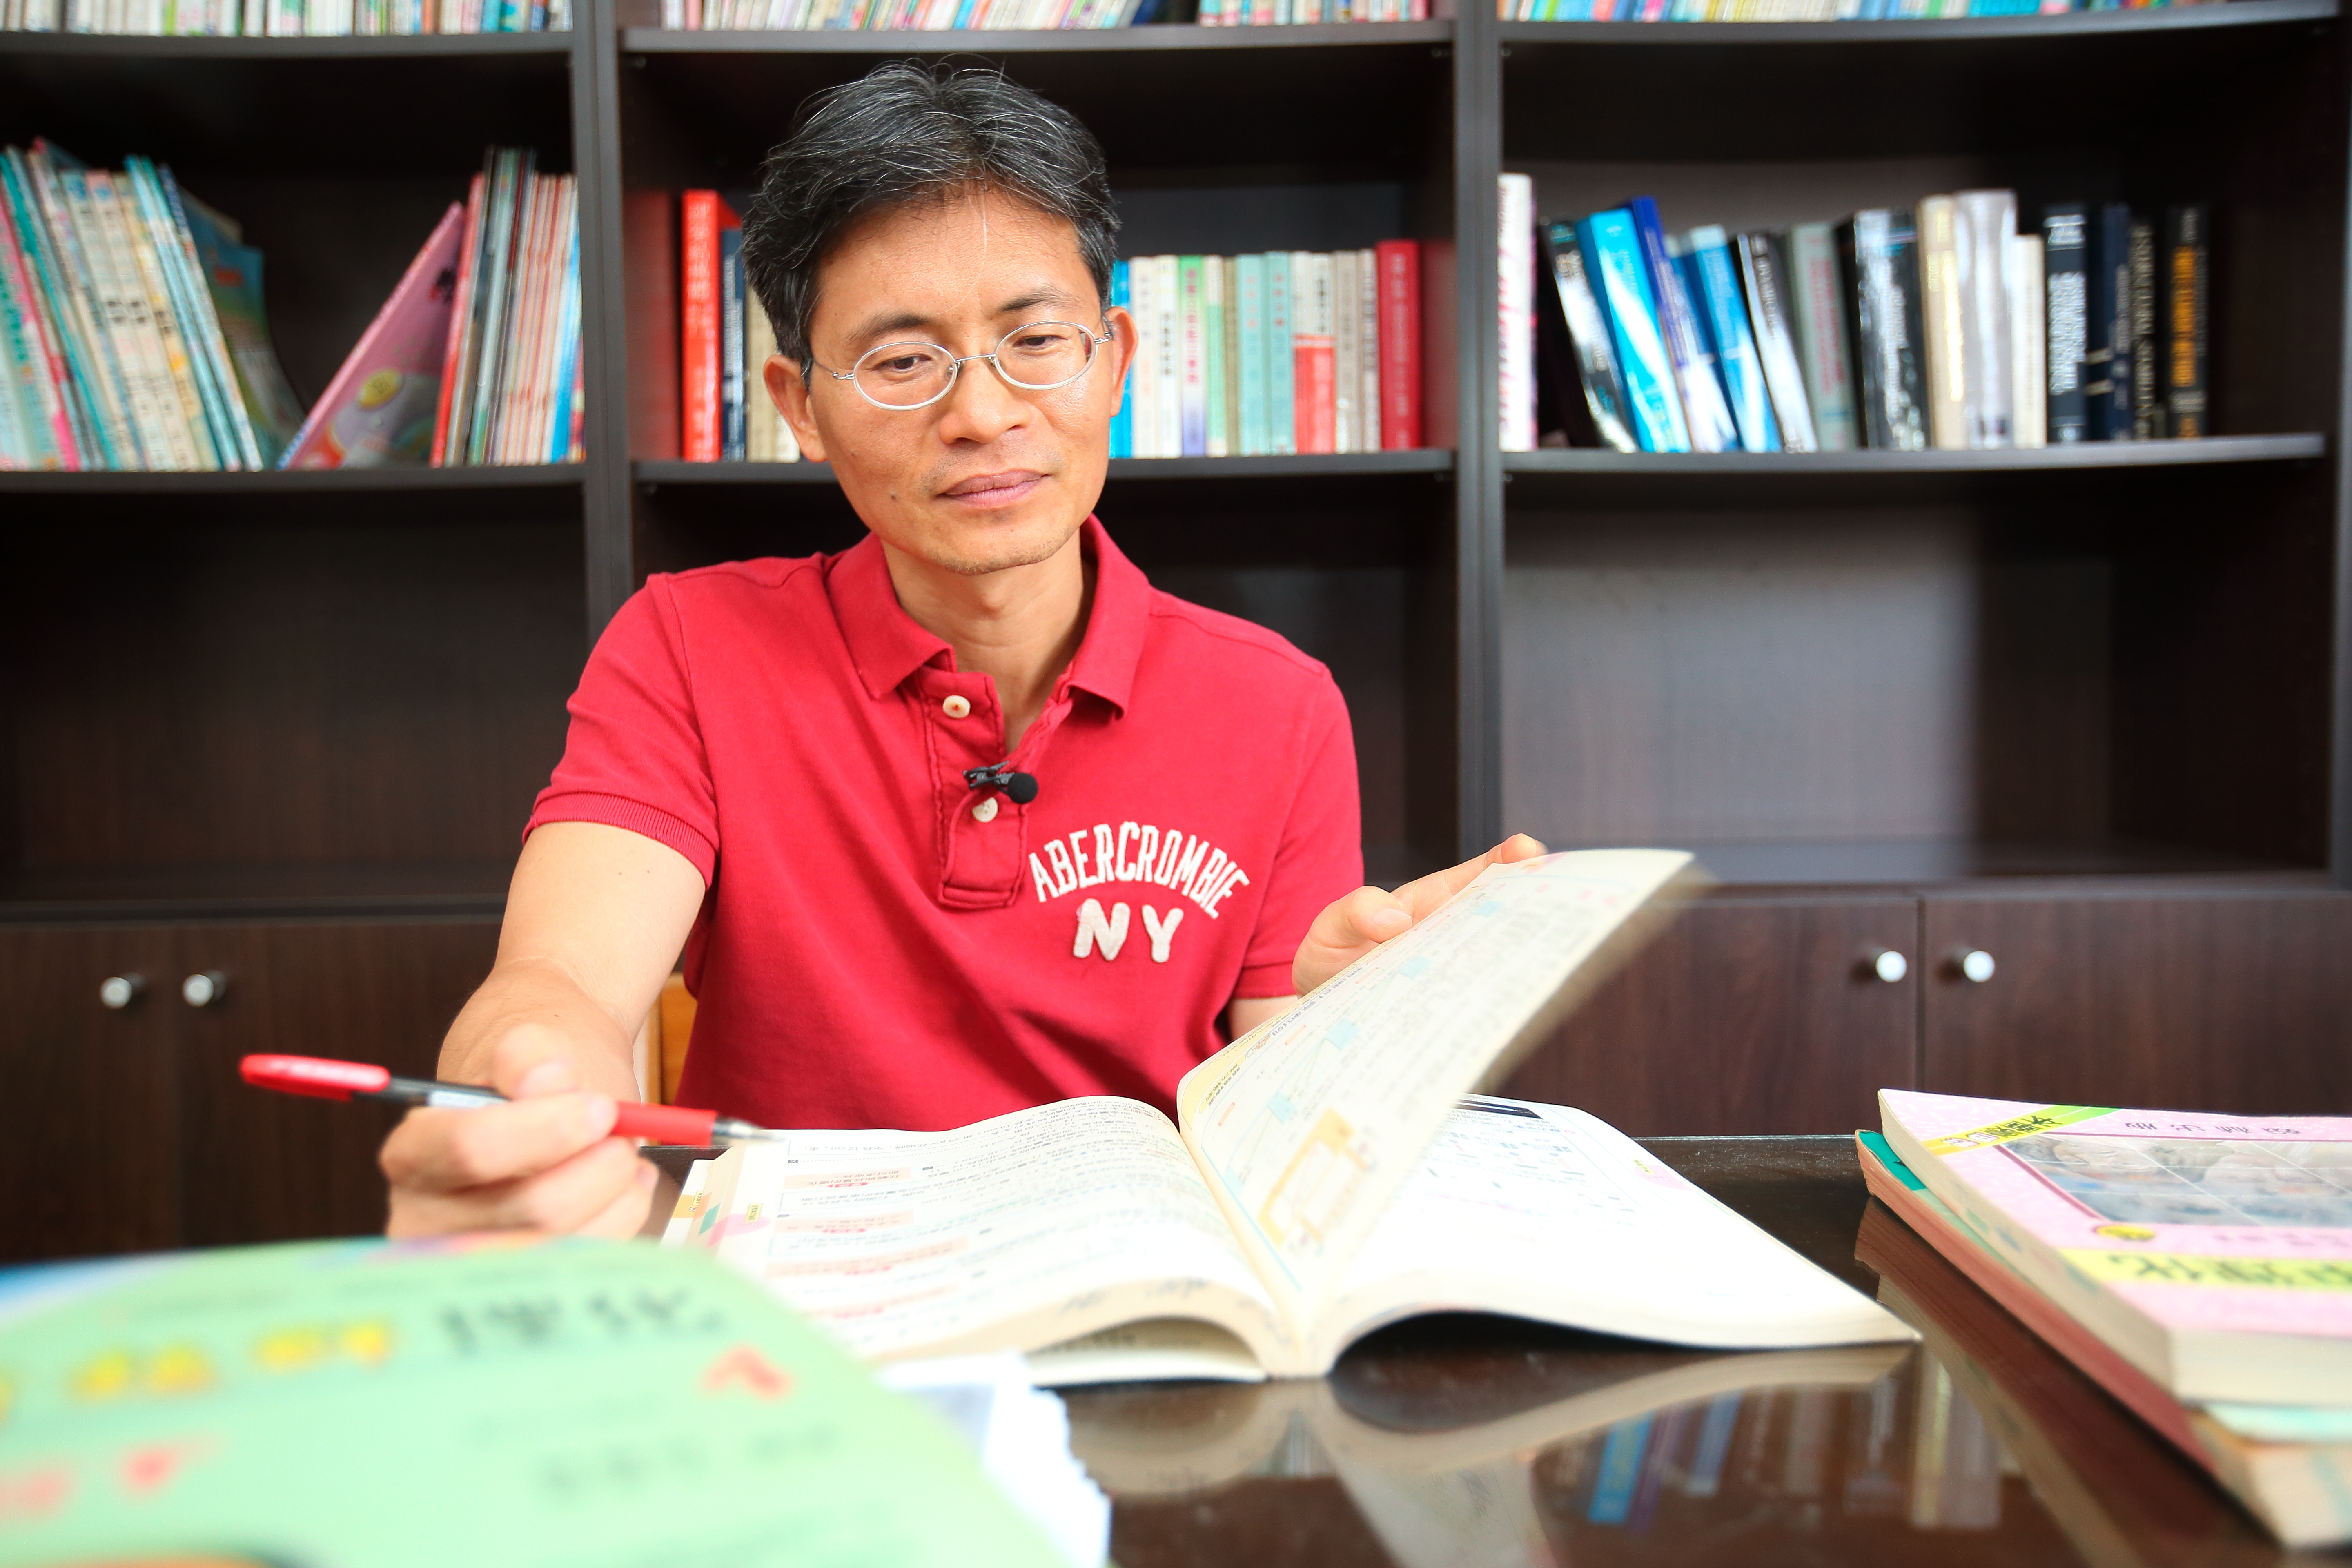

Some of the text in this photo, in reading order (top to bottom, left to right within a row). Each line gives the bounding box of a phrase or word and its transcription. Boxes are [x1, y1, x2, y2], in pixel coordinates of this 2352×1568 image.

[1029, 821, 1250, 920] ABERCROMBIE
[2122, 1122, 2301, 1134] 翰林出版
